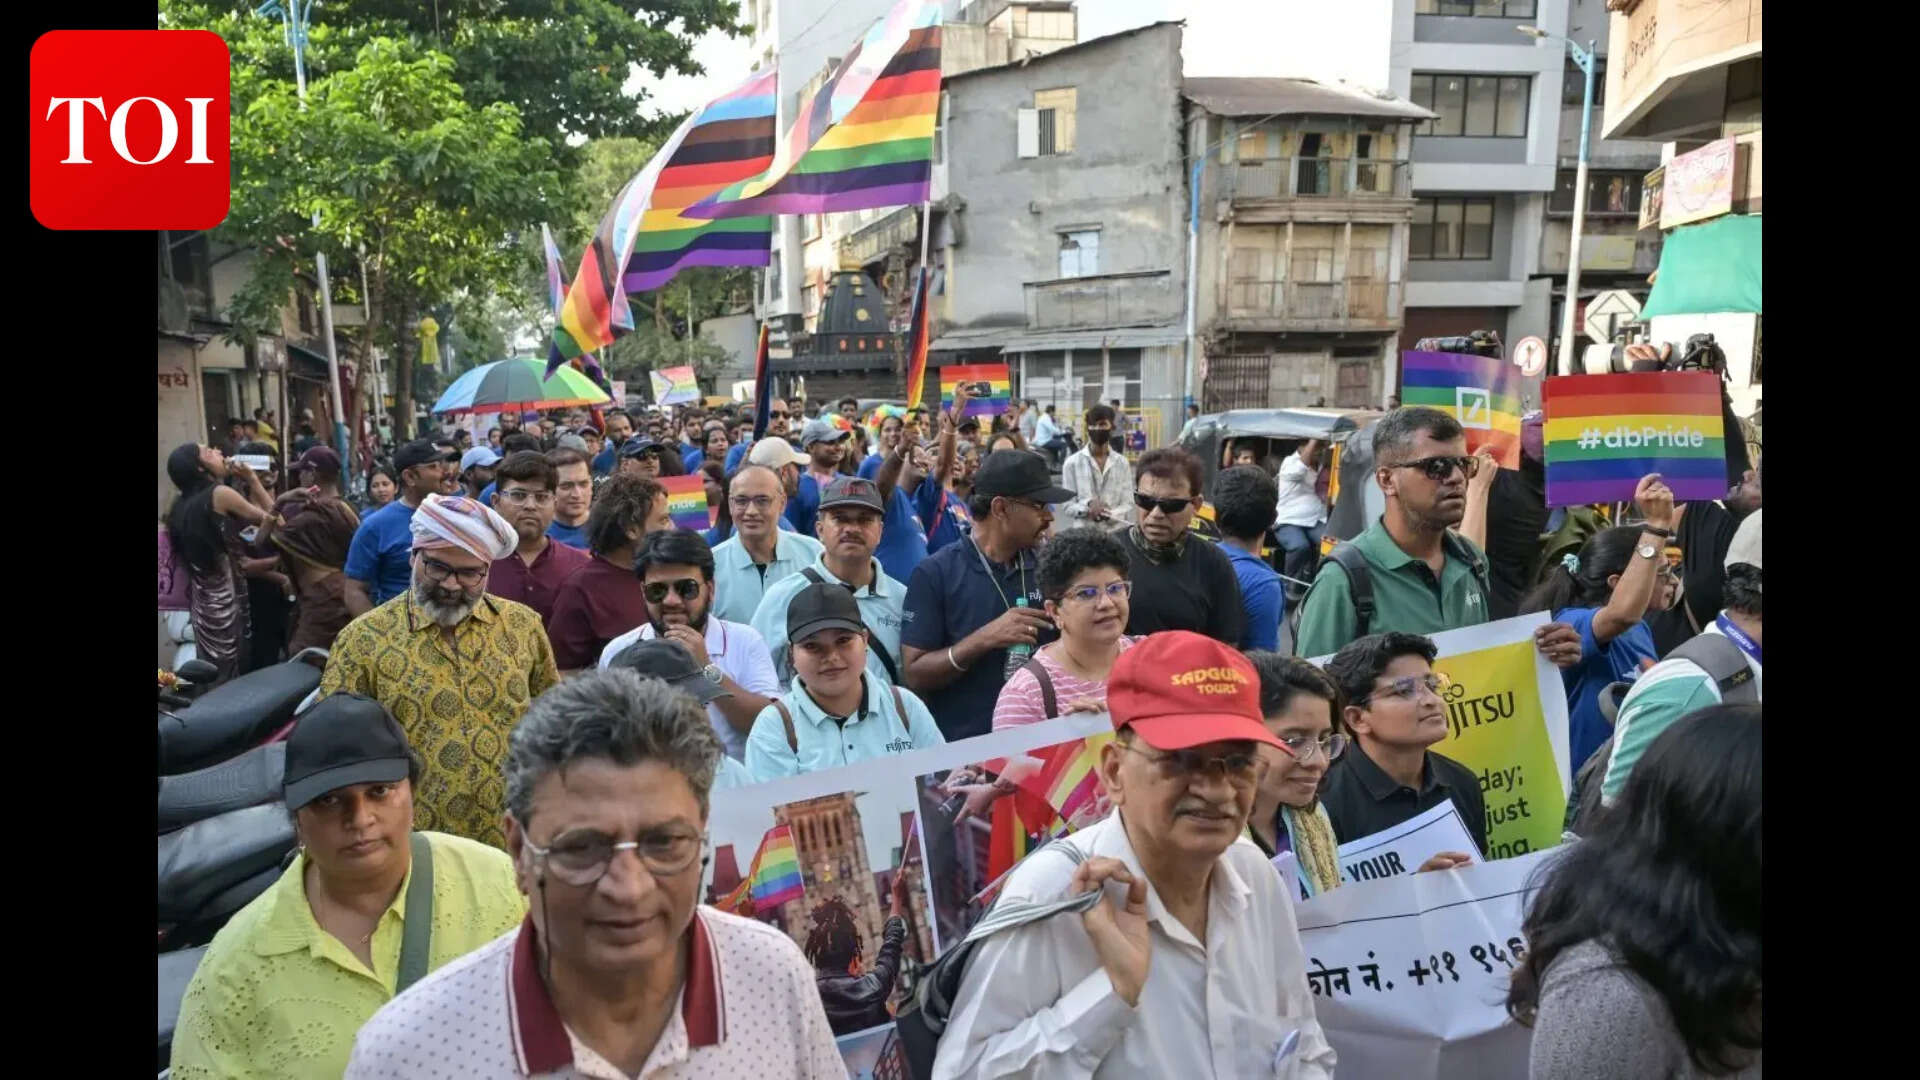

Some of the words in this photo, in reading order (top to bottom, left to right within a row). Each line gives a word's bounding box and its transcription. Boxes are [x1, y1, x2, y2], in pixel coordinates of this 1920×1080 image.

[1577, 425, 1704, 449] #dbPride
[1196, 683, 1238, 695] TOURS
[1446, 691, 1515, 740] JITSU
[1486, 797, 1530, 834] just
[1356, 950, 1394, 992] नं.
